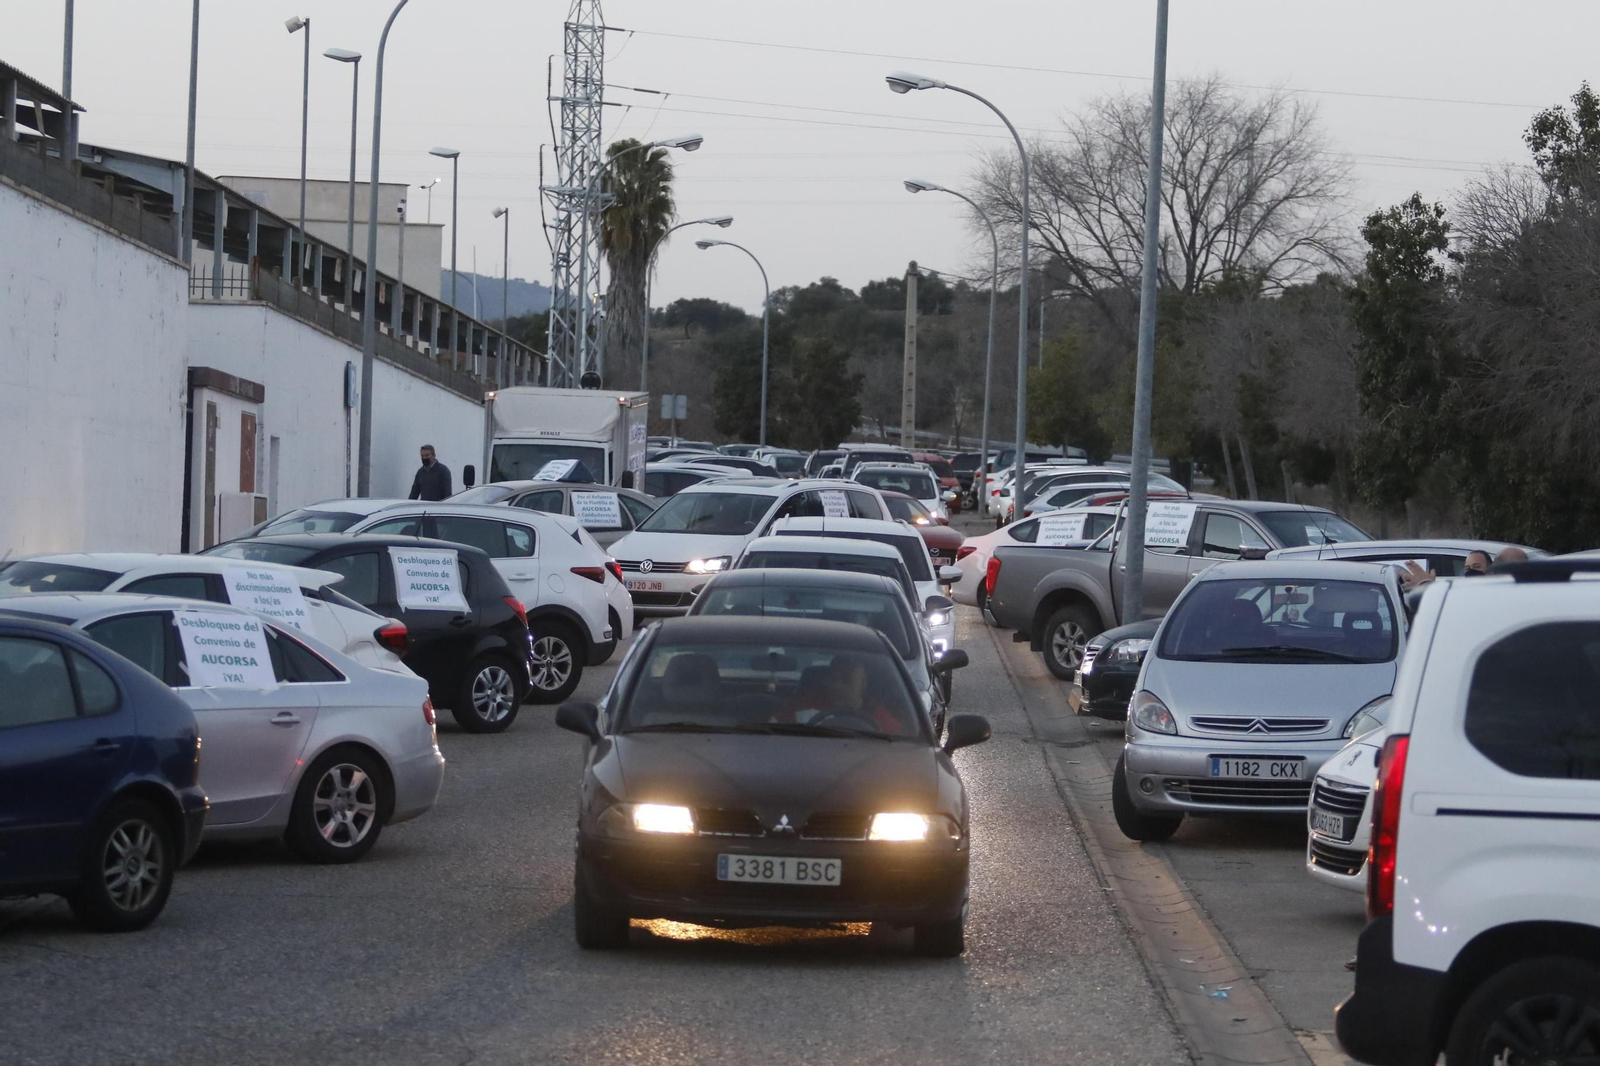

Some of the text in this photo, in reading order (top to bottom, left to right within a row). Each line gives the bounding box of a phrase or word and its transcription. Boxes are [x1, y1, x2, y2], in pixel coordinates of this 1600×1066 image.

[397, 556, 440, 566] Desbloqueo
[246, 572, 258, 580] No
[406, 570, 449, 578] Convenio de
[235, 582, 292, 594] discriminaciones
[410, 583, 450, 591] AUCORSA
[628, 582, 646, 590] 9120
[259, 596, 281, 606] los/as
[295, 608, 305, 616] de
[181, 618, 259, 632] Desbloqueo del
[194, 636, 256, 648] Convenio de
[201, 654, 258, 666] AUCORSA
[223, 673, 244, 683] ¡YA!
[1224, 761, 1260, 776] 1182
[1270, 762, 1298, 778] CKX
[734, 858, 836, 882] 3381 BSC
